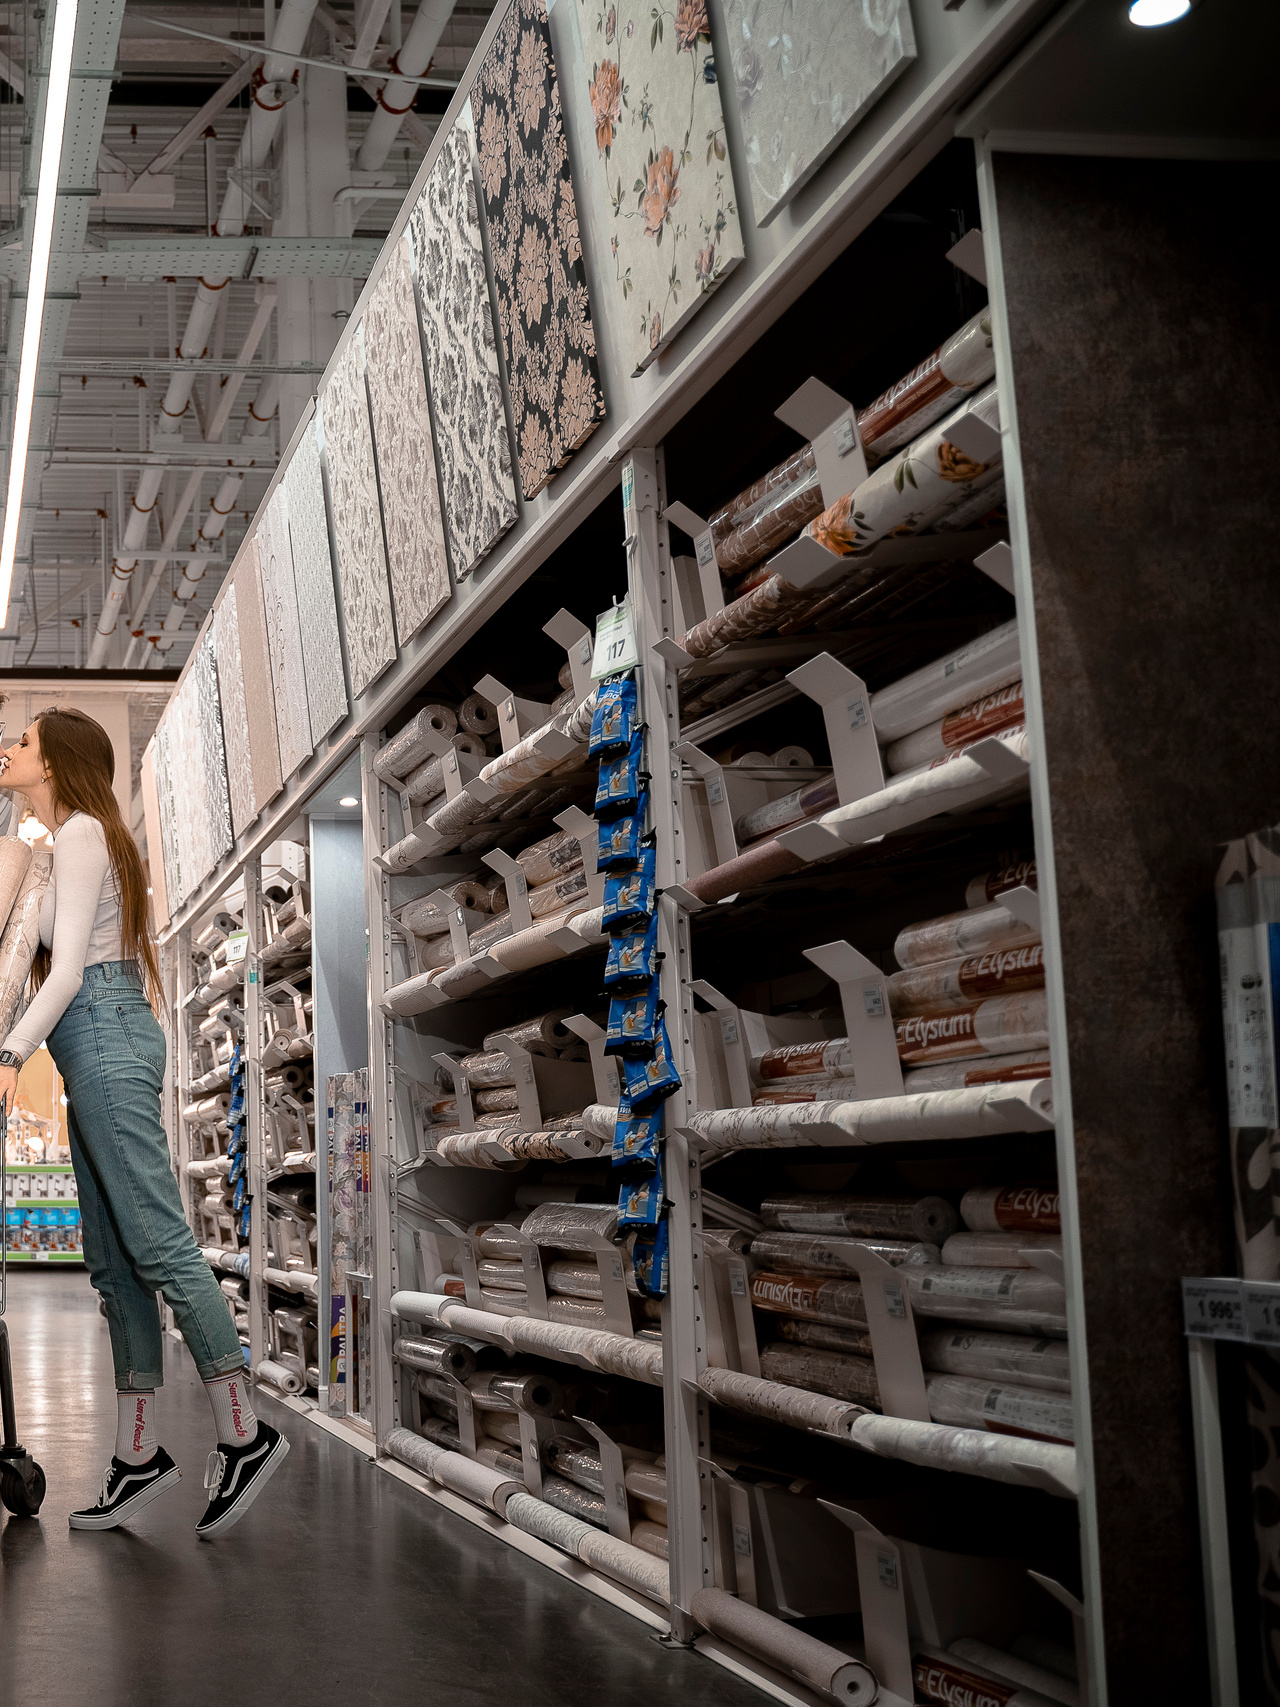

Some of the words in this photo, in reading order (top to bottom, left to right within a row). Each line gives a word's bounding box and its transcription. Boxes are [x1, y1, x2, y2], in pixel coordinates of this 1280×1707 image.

[606, 638, 626, 662] 117
[905, 1012, 971, 1047] Elysium
[774, 1039, 830, 1063] Elysium
[753, 1279, 802, 1311] Elysium
[228, 1382, 238, 1401] Sun
[136, 1398, 147, 1414] Sun
[232, 1408, 248, 1438] Beach
[132, 1423, 146, 1453] Beach
